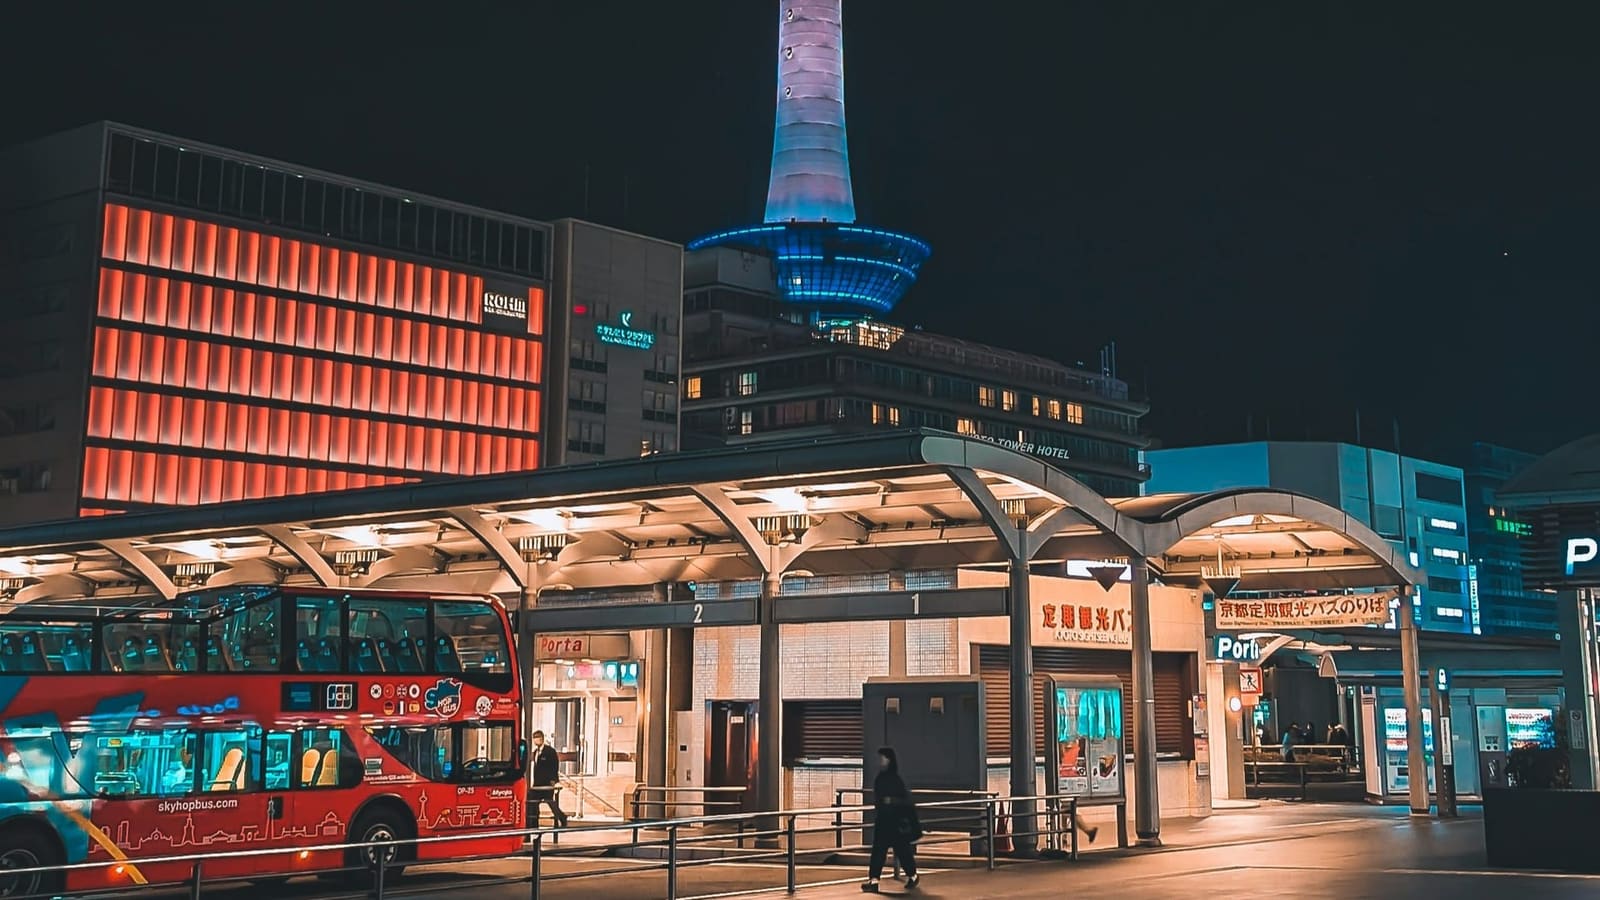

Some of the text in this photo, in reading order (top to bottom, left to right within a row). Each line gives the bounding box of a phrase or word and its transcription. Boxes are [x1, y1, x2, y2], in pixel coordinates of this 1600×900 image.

[1036, 445, 1070, 459] HOTEL
[1565, 537, 1598, 575] P
[693, 603, 703, 623] 2
[911, 593, 920, 615] 1
[1220, 596, 1385, 618] 京都定期観光バスのりば
[540, 638, 582, 652] Porta
[158, 799, 238, 813] skyhopbus.com
